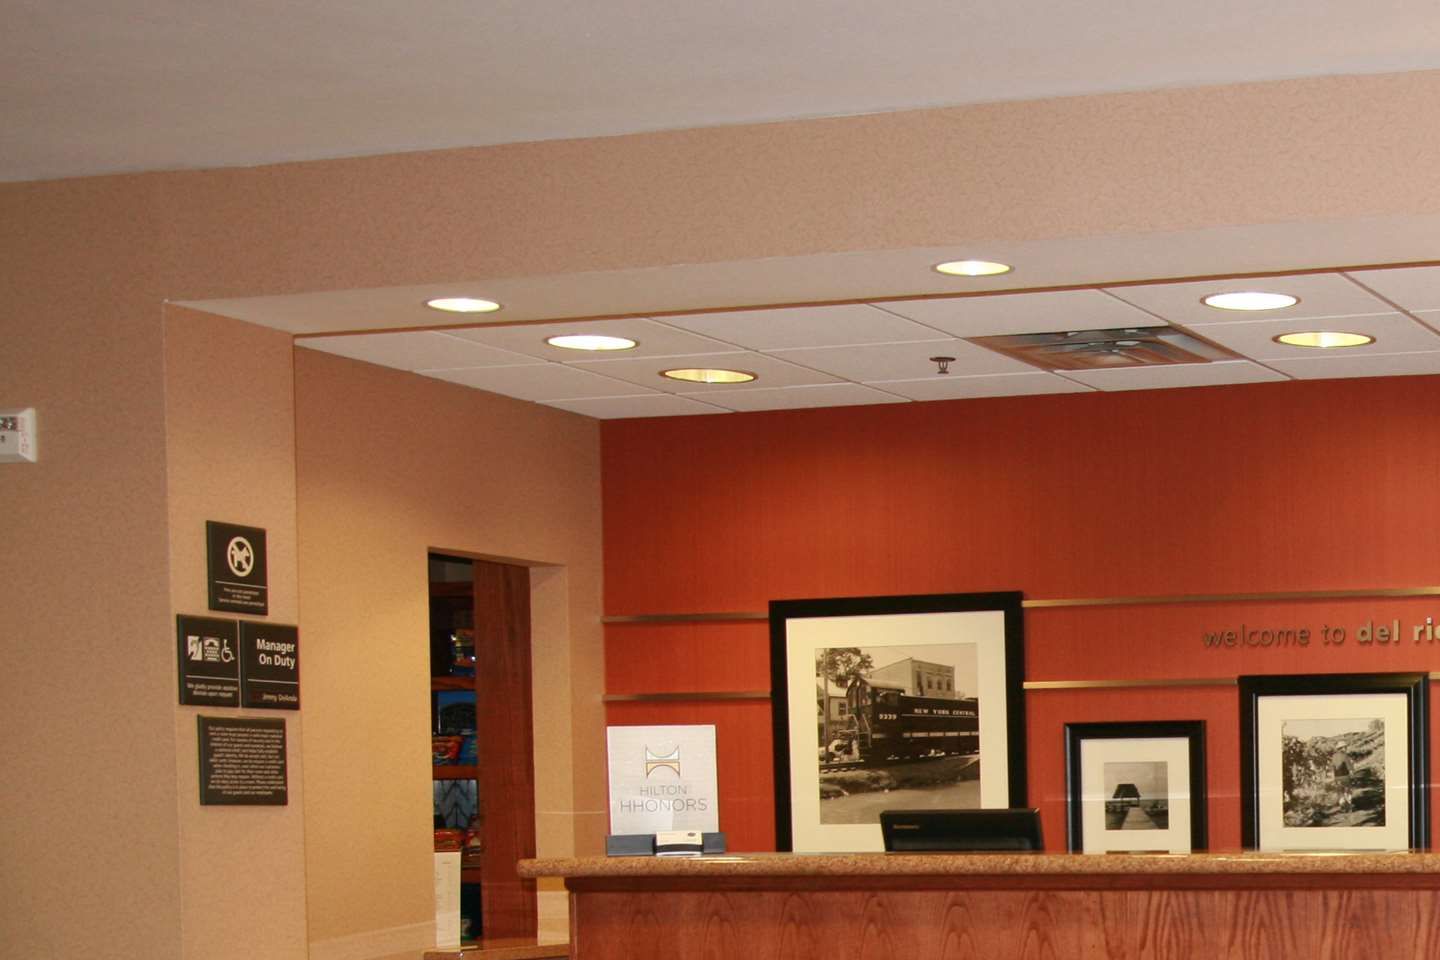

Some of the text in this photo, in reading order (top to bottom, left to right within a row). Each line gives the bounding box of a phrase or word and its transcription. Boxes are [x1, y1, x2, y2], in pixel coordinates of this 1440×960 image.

[1203, 624, 1311, 648] welcome
[1321, 624, 1346, 645] to
[1356, 619, 1400, 642] del
[256, 638, 295, 655] Manager
[259, 653, 296, 670] On Duty
[639, 785, 688, 796] HILTON
[620, 798, 708, 814] HHONORS
